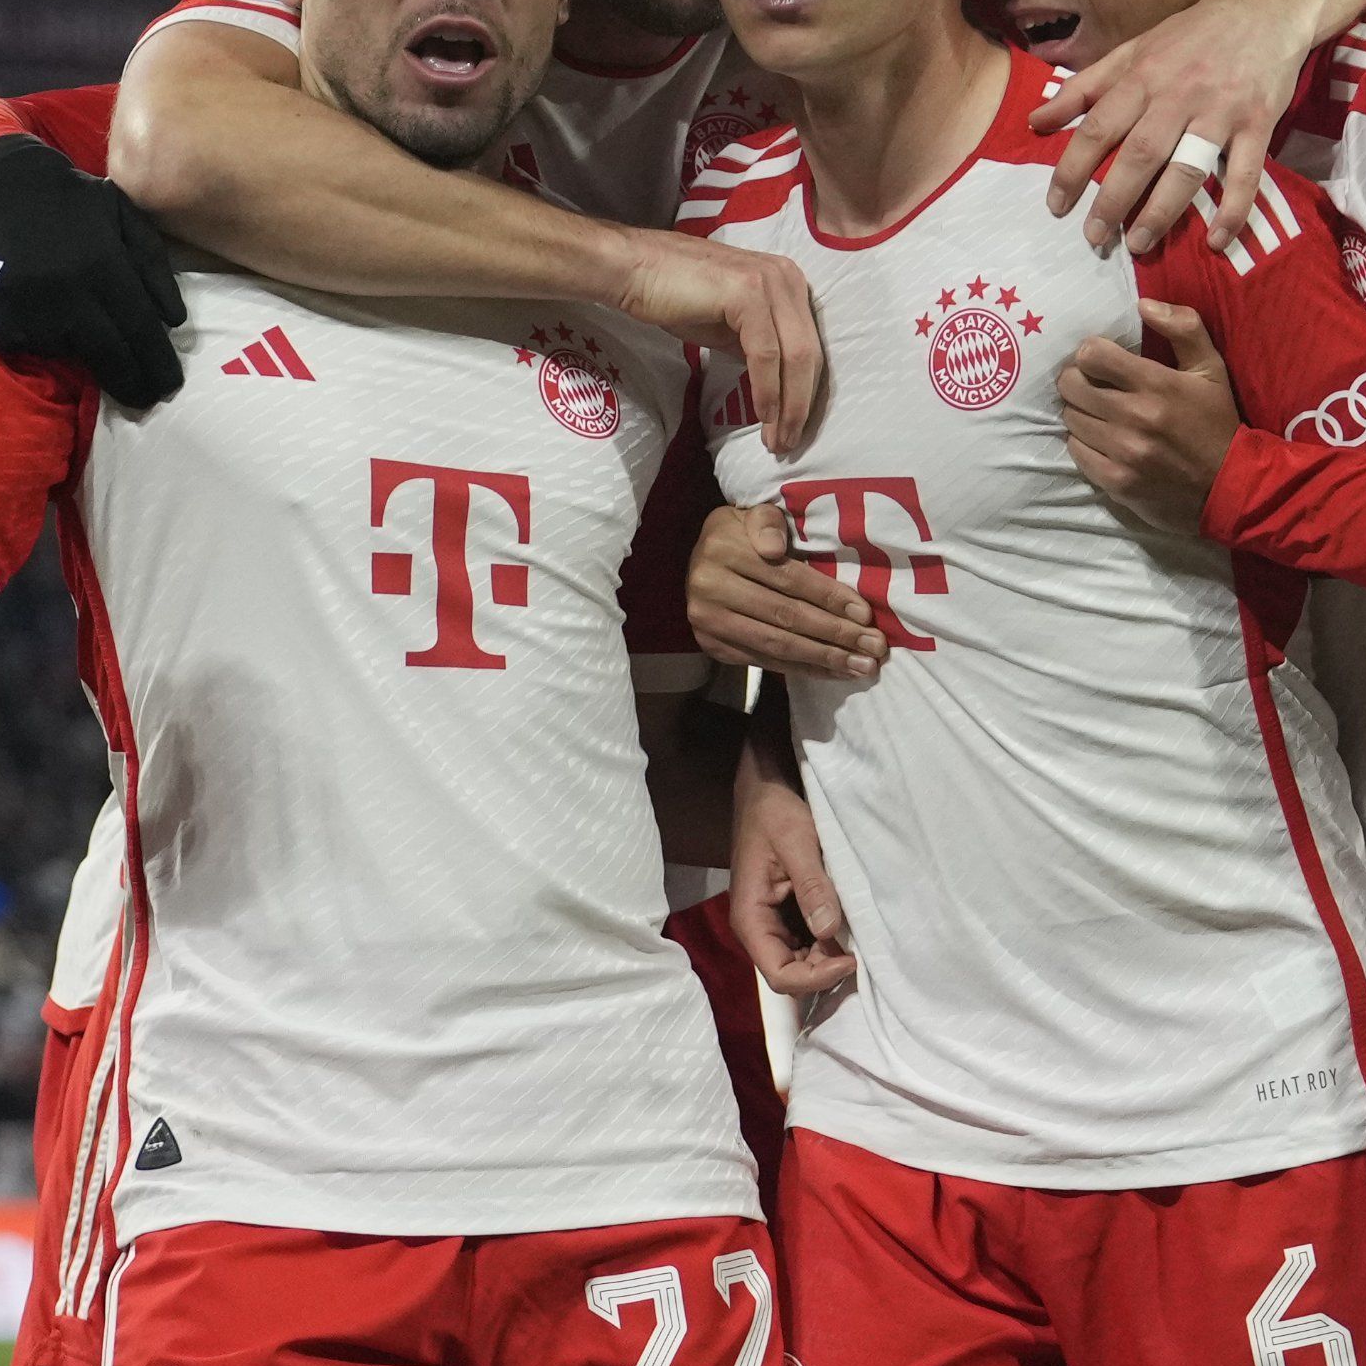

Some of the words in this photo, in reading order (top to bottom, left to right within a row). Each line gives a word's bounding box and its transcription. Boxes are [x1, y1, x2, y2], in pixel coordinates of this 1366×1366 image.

[695, 119, 749, 141] BAYER
[936, 328, 954, 352] FC
[954, 315, 1012, 352] BAYERN
[545, 363, 561, 384] FC
[557, 355, 611, 392] BAYERN
[935, 367, 1012, 404] MÜNCHEN
[551, 397, 616, 433] MÜNCHEN
[370, 458, 531, 670] T
